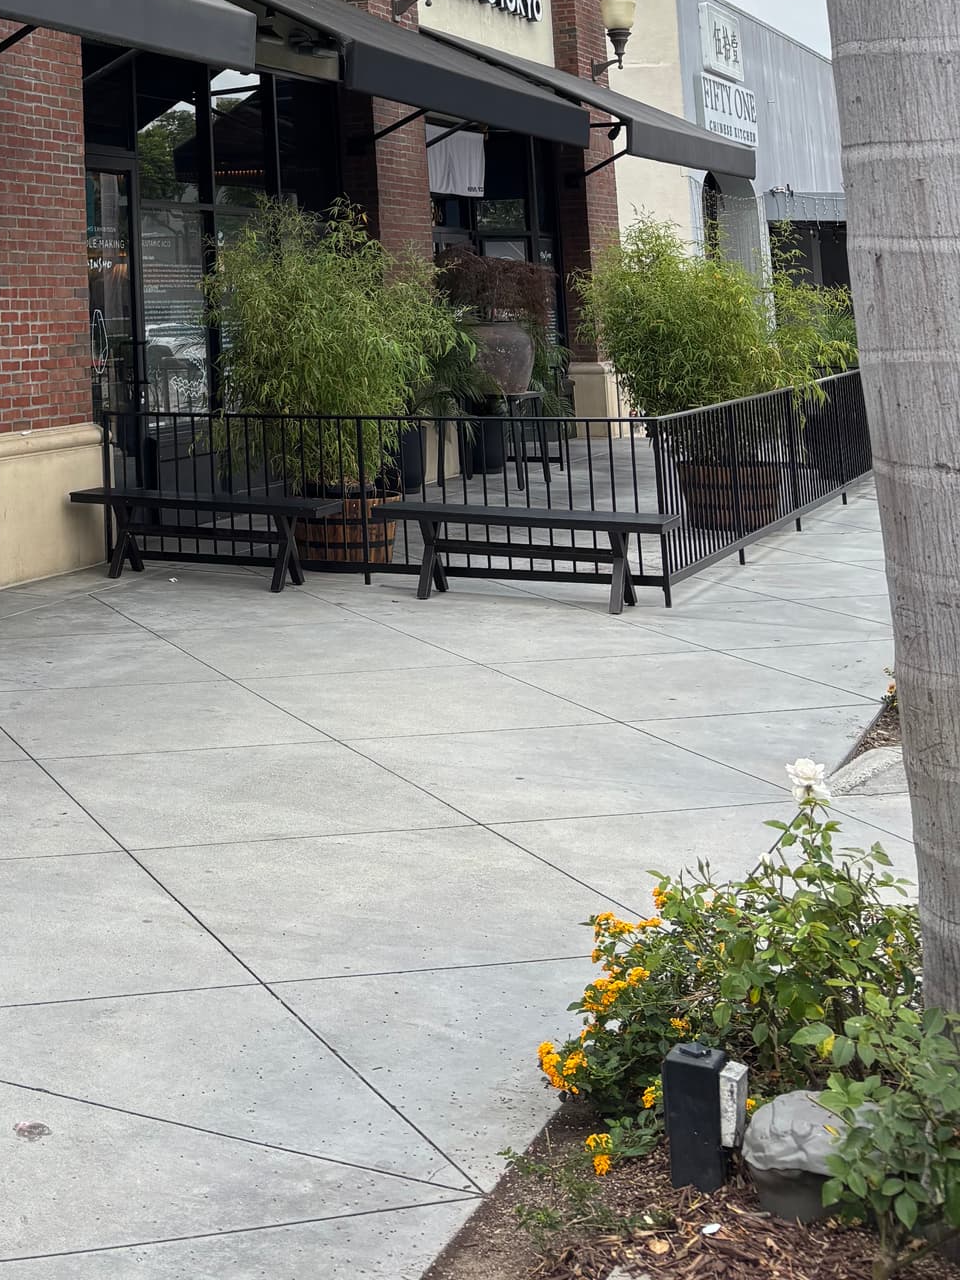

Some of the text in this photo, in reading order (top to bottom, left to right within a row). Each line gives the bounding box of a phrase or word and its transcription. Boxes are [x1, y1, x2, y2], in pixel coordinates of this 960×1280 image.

[702, 76, 757, 124] FIFTY ONE
[709, 119, 757, 143] CHINESE KITCHEN
[100, 239, 125, 249] MAKING
[88, 257, 113, 272] ENSHO
